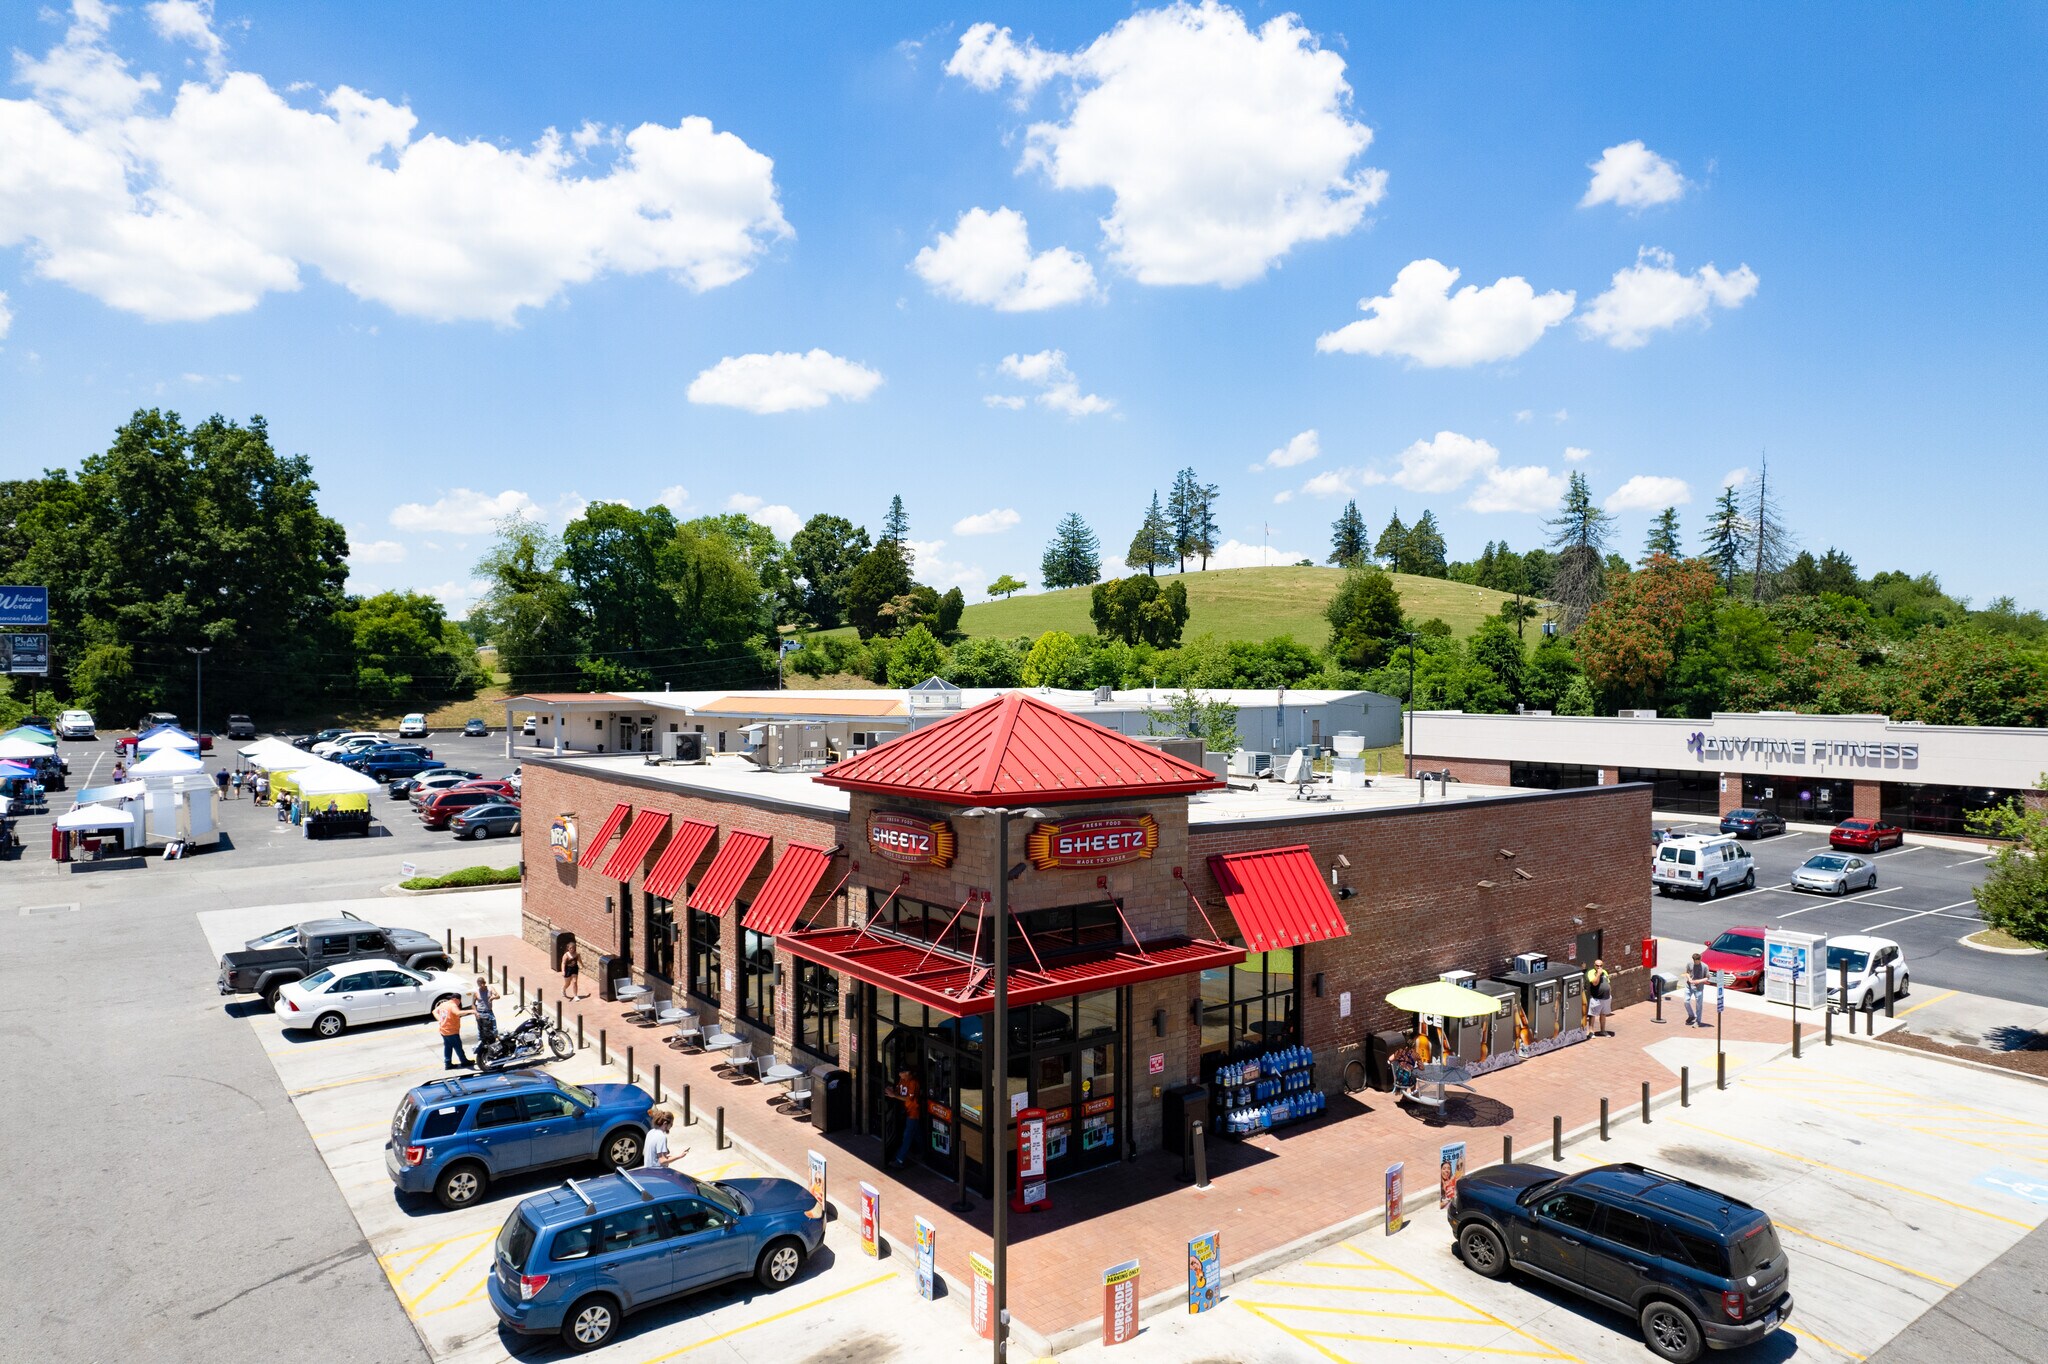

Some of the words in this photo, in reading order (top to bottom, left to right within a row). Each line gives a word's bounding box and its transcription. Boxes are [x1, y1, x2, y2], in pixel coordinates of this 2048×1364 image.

[872, 827, 929, 851] SHEETZ
[1059, 831, 1143, 854] SHEETZ
[1106, 855, 1126, 863] ORDER
[1532, 961, 1545, 973] ICE
[1107, 1272, 1129, 1284] PARKING
[1129, 1268, 1139, 1277] ONLY
[1114, 1283, 1125, 1342] CURBSIDE
[1125, 1280, 1133, 1323] PICKUP
